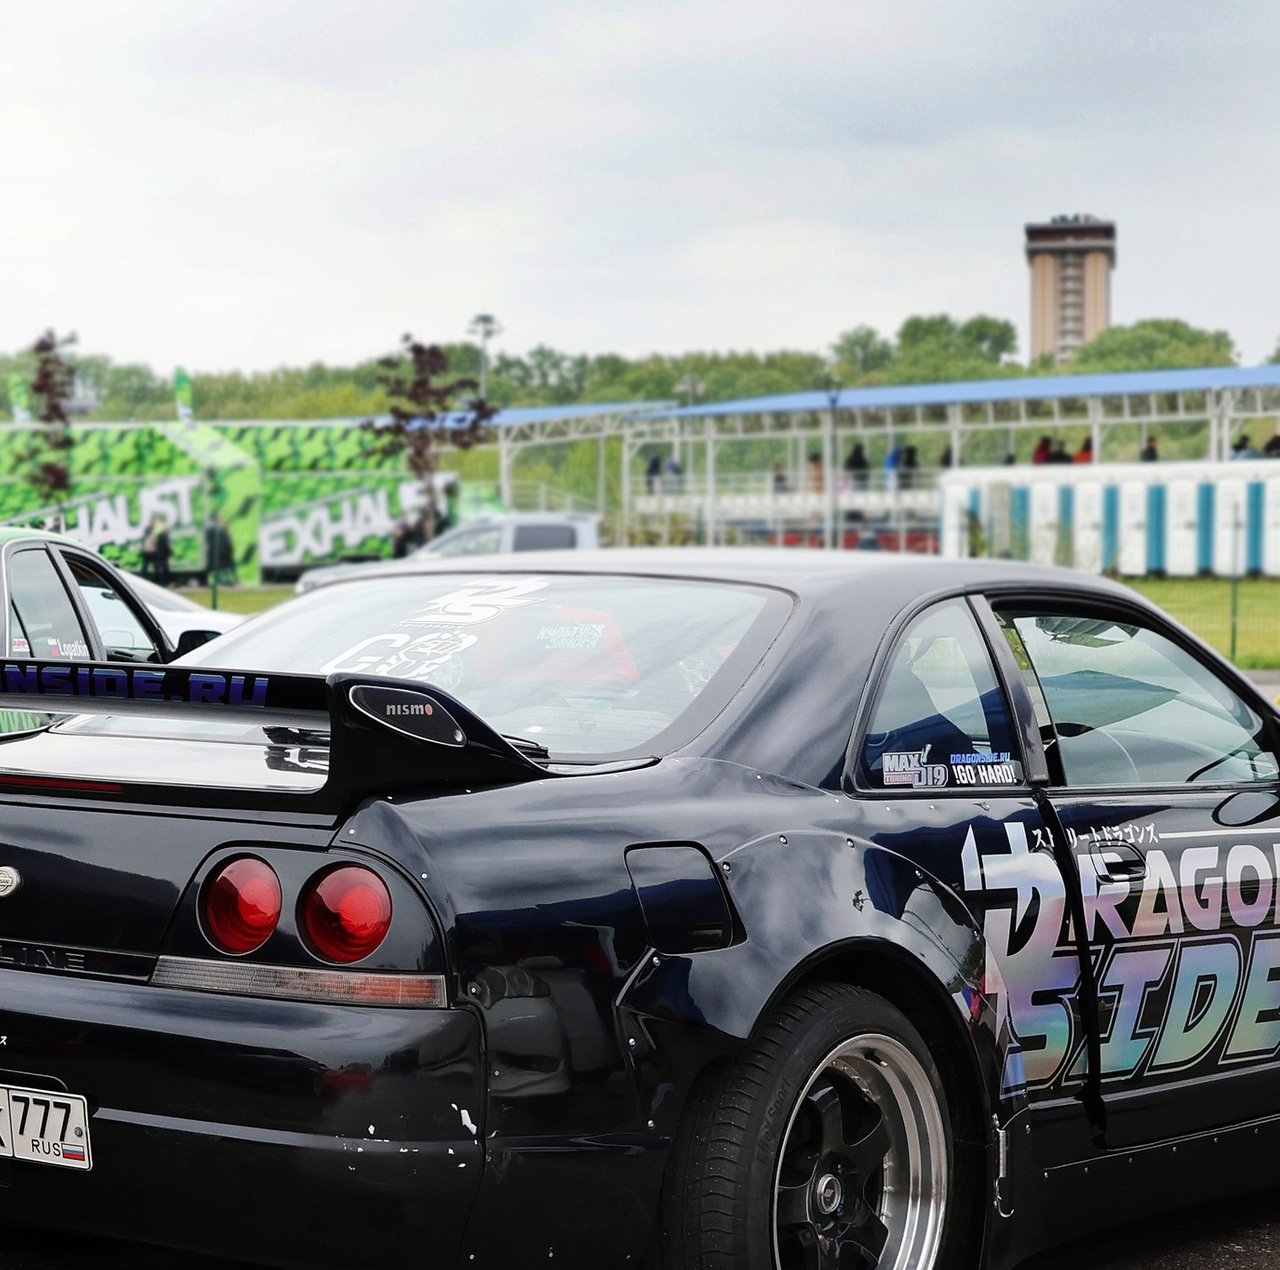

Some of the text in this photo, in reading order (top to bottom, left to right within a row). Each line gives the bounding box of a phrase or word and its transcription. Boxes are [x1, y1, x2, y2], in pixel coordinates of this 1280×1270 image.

[386, 703, 433, 716] nismo
[884, 754, 920, 772] MAX
[977, 765, 1017, 783] HARD!
[961, 821, 1280, 963] DRAGO
[12, 1095, 71, 1141] 777
[31, 1139, 61, 1157] RUS
